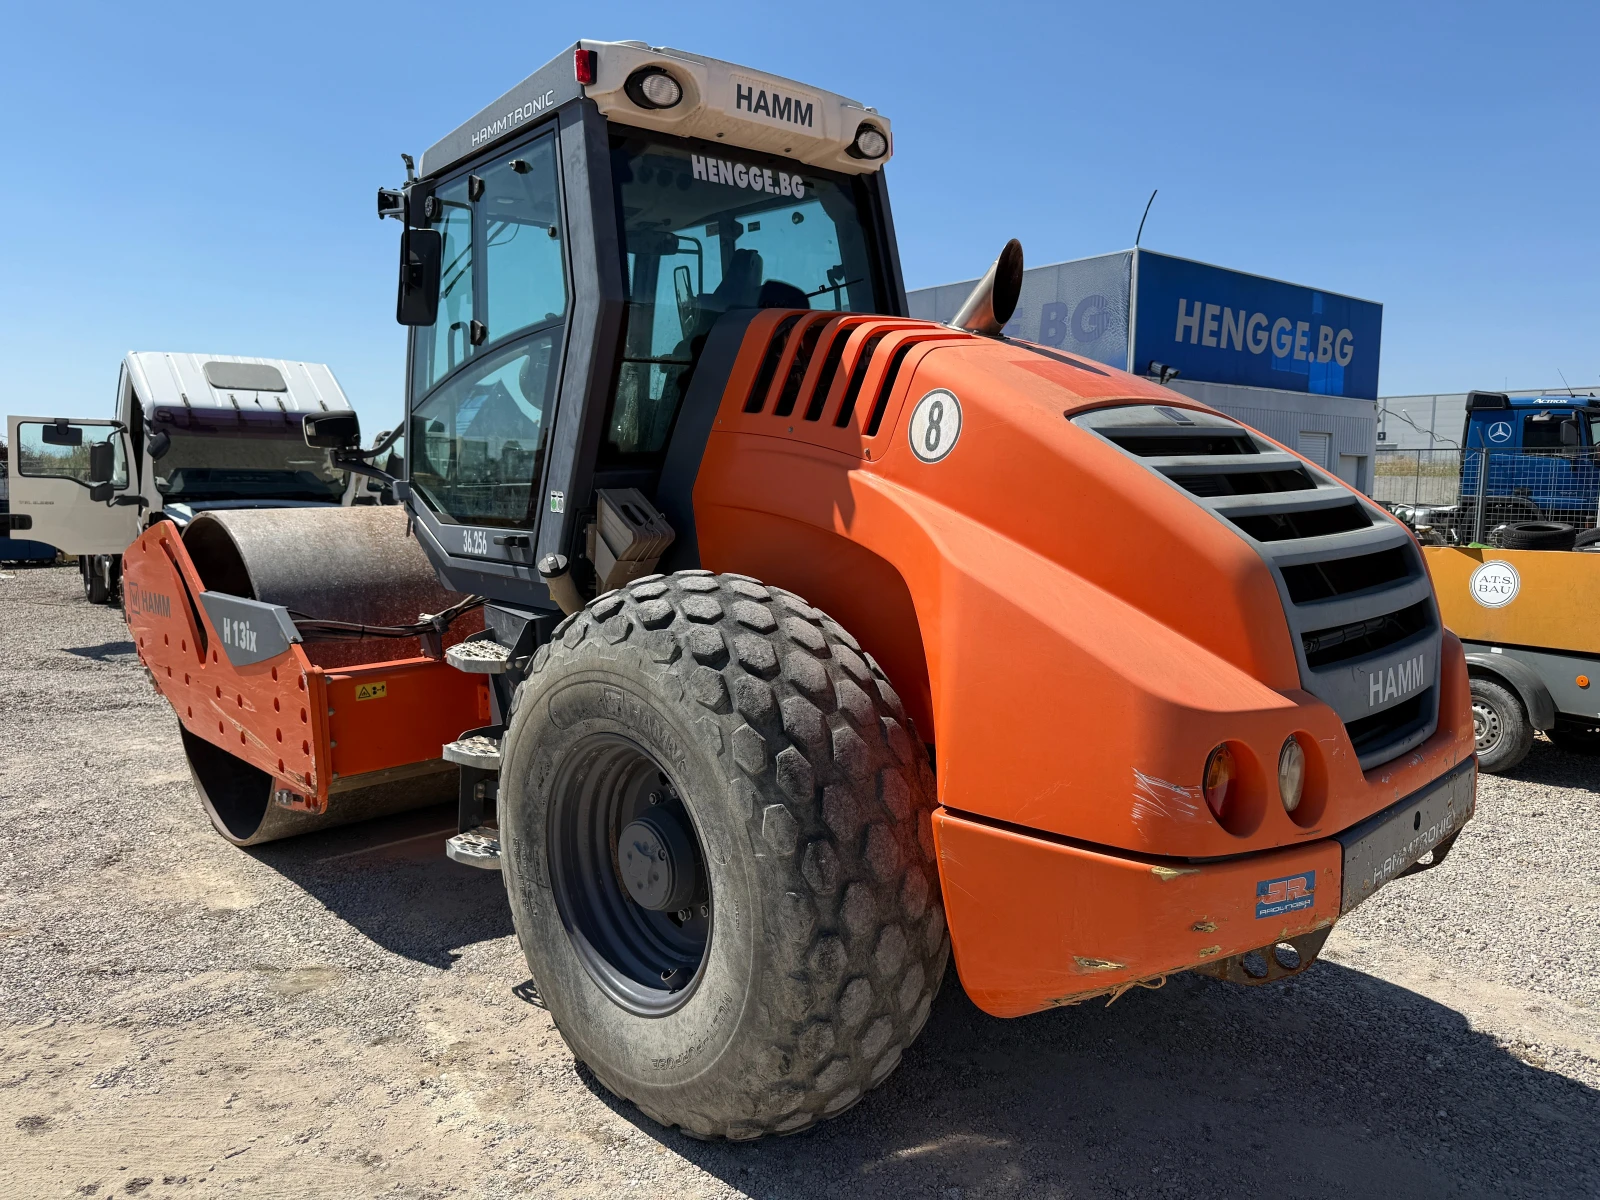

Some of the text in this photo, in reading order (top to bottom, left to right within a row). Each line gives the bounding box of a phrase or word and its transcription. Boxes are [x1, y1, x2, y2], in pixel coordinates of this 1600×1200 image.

[471, 89, 554, 147] HAMMTRONIC
[736, 83, 813, 128] HAMM
[691, 154, 805, 199] HENGGE.BG
[1174, 298, 1354, 367] HENGGE.BG
[925, 400, 943, 452] 8
[463, 530, 487, 554] 36.256
[141, 590, 171, 618] HAMM
[1479, 584, 1511, 594] BAU
[223, 617, 257, 652] H 13ix
[1369, 653, 1424, 707] HAMM
[1373, 812, 1453, 884] HAMMTRONIC
